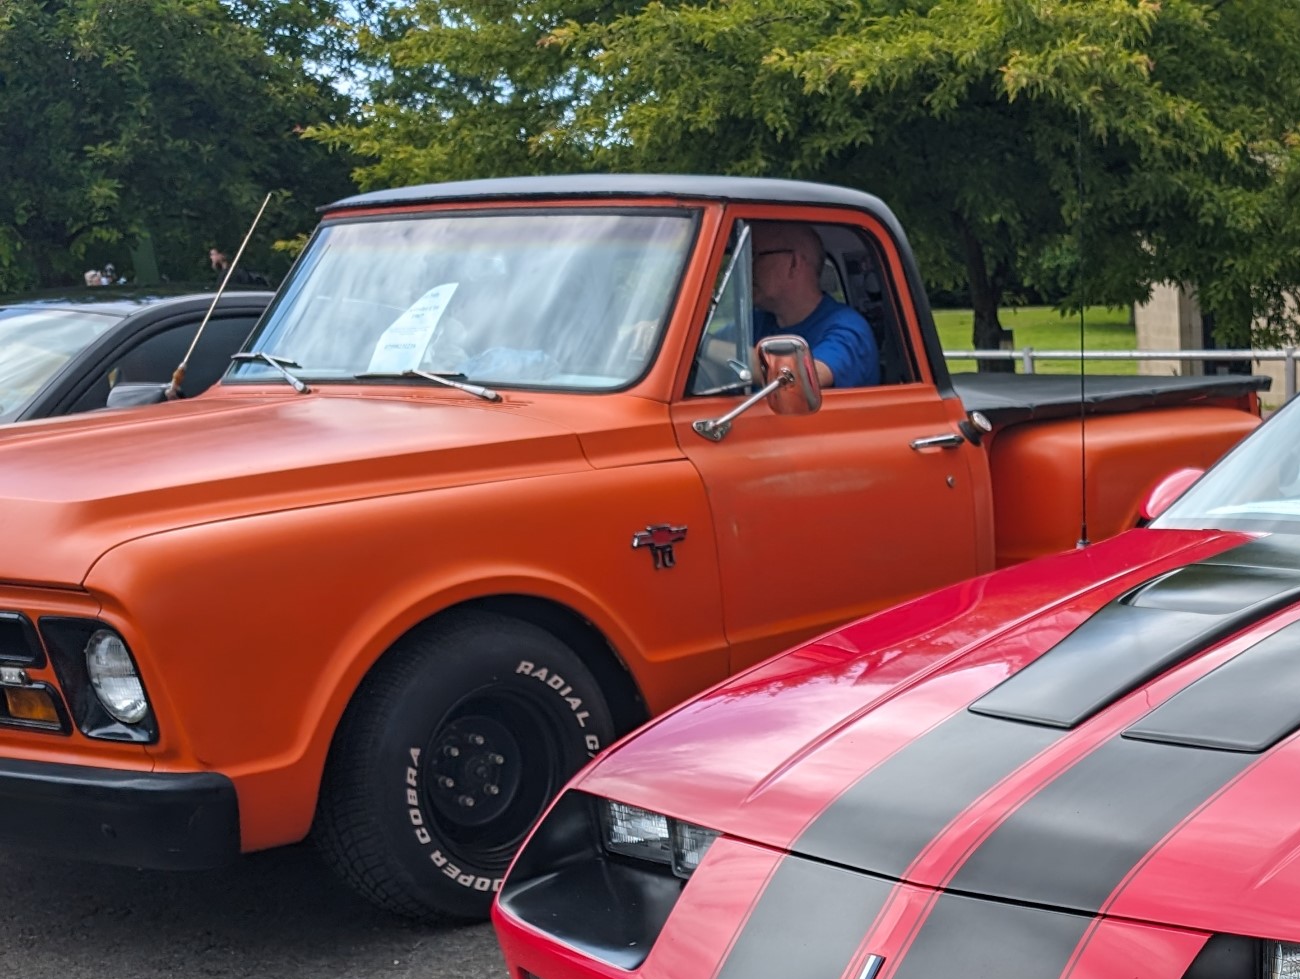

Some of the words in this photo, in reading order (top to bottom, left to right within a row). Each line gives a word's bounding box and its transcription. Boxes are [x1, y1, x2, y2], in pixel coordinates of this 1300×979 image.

[515, 660, 590, 728] RADIAL
[406, 747, 432, 845] COBRA
[431, 850, 505, 892] OOPER
